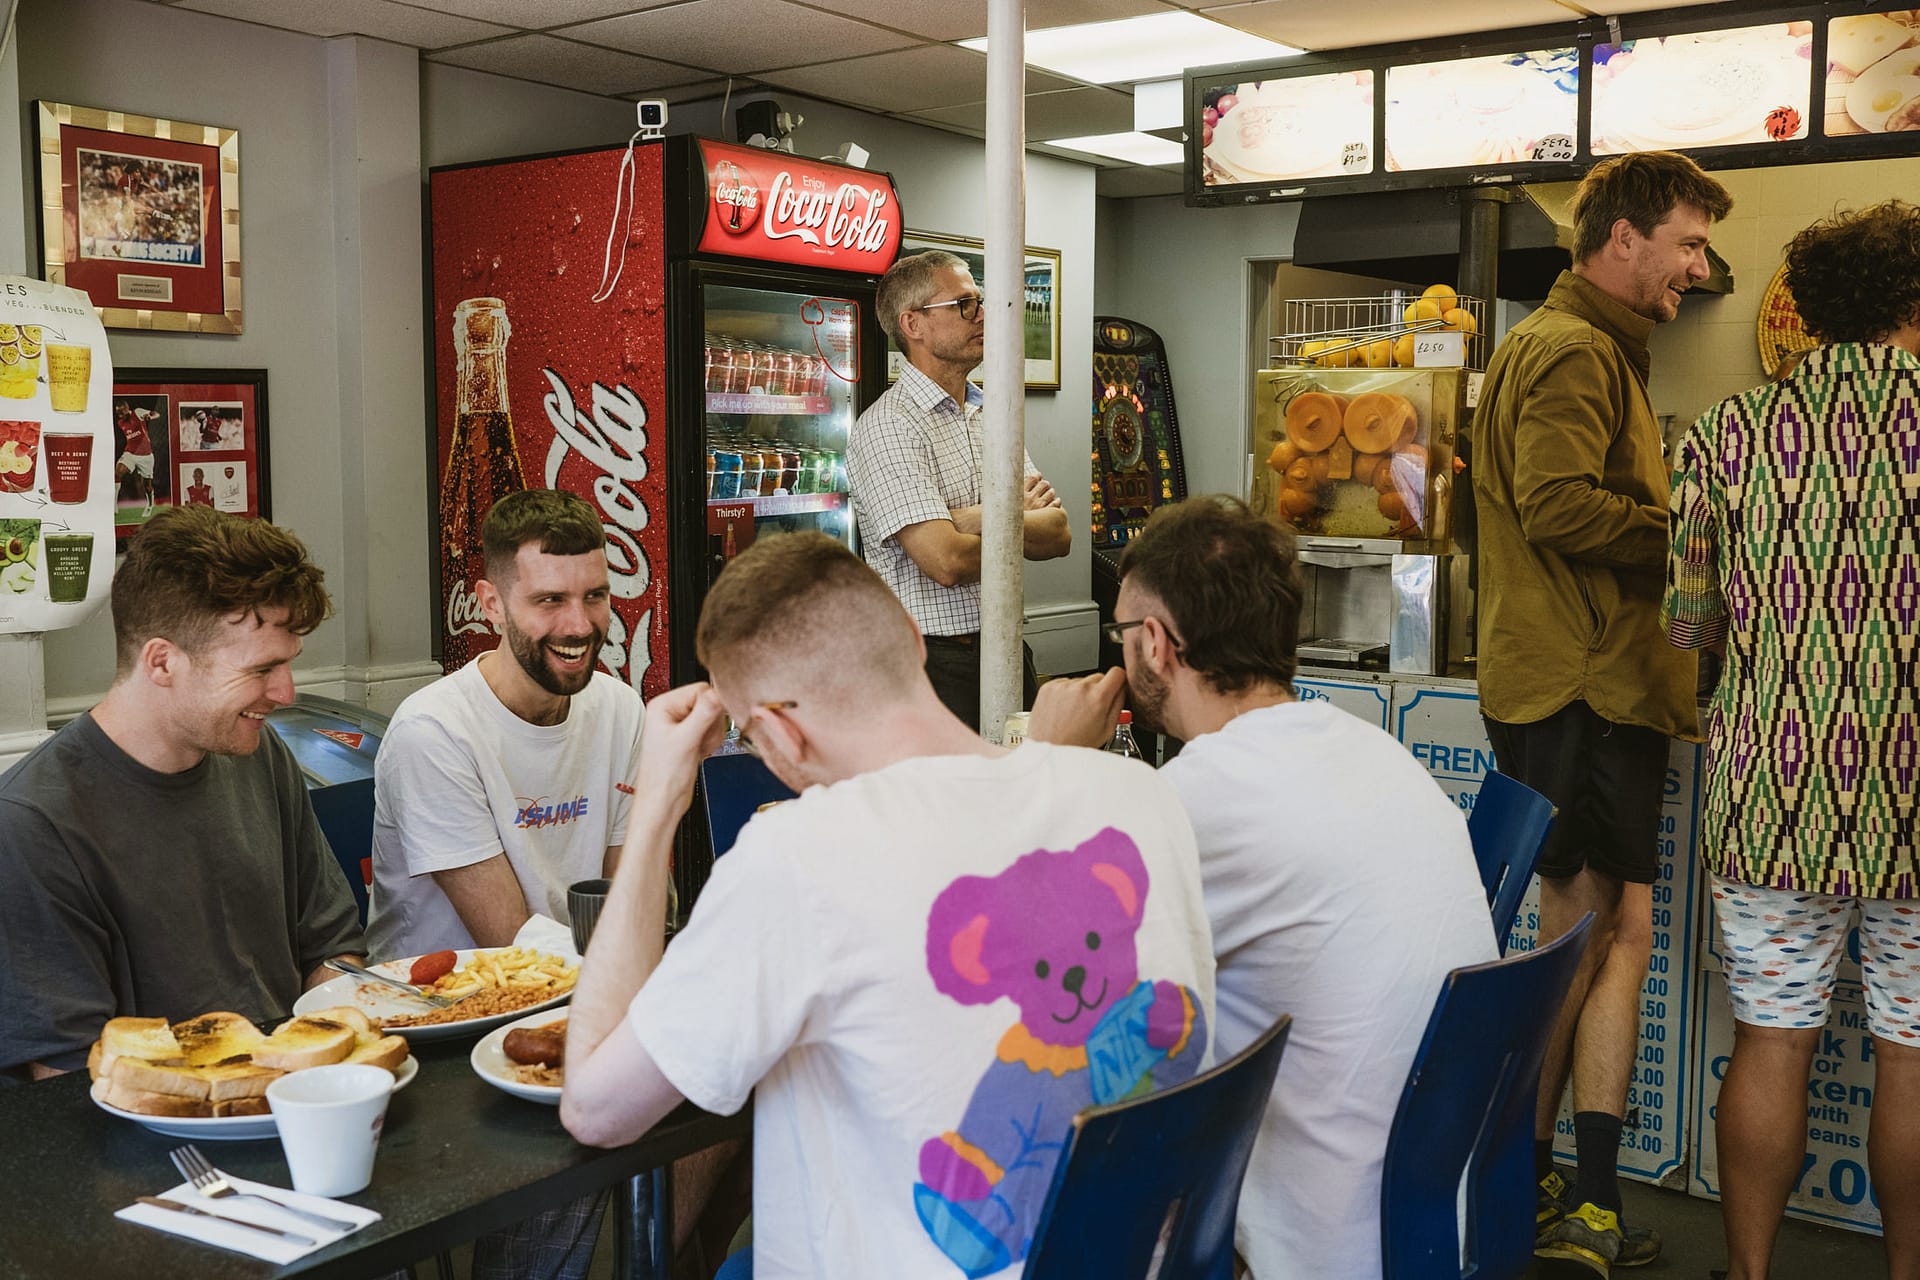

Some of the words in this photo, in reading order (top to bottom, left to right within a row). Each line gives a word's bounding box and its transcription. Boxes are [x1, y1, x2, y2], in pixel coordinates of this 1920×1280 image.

[802, 175, 826, 192] Enjoy
[716, 182, 758, 209] Coca-Cola
[764, 171, 889, 252] Coca-Cola
[711, 398, 727, 409] Pick
[729, 399, 742, 410] me
[742, 401, 753, 412] up
[754, 398, 771, 410] with
[788, 400, 806, 410] meal
[716, 507, 746, 519] Thirsty?
[1815, 1058, 1843, 1076] or
[1628, 1087, 1664, 1110] 3.00
[1807, 1104, 1850, 1125] with
